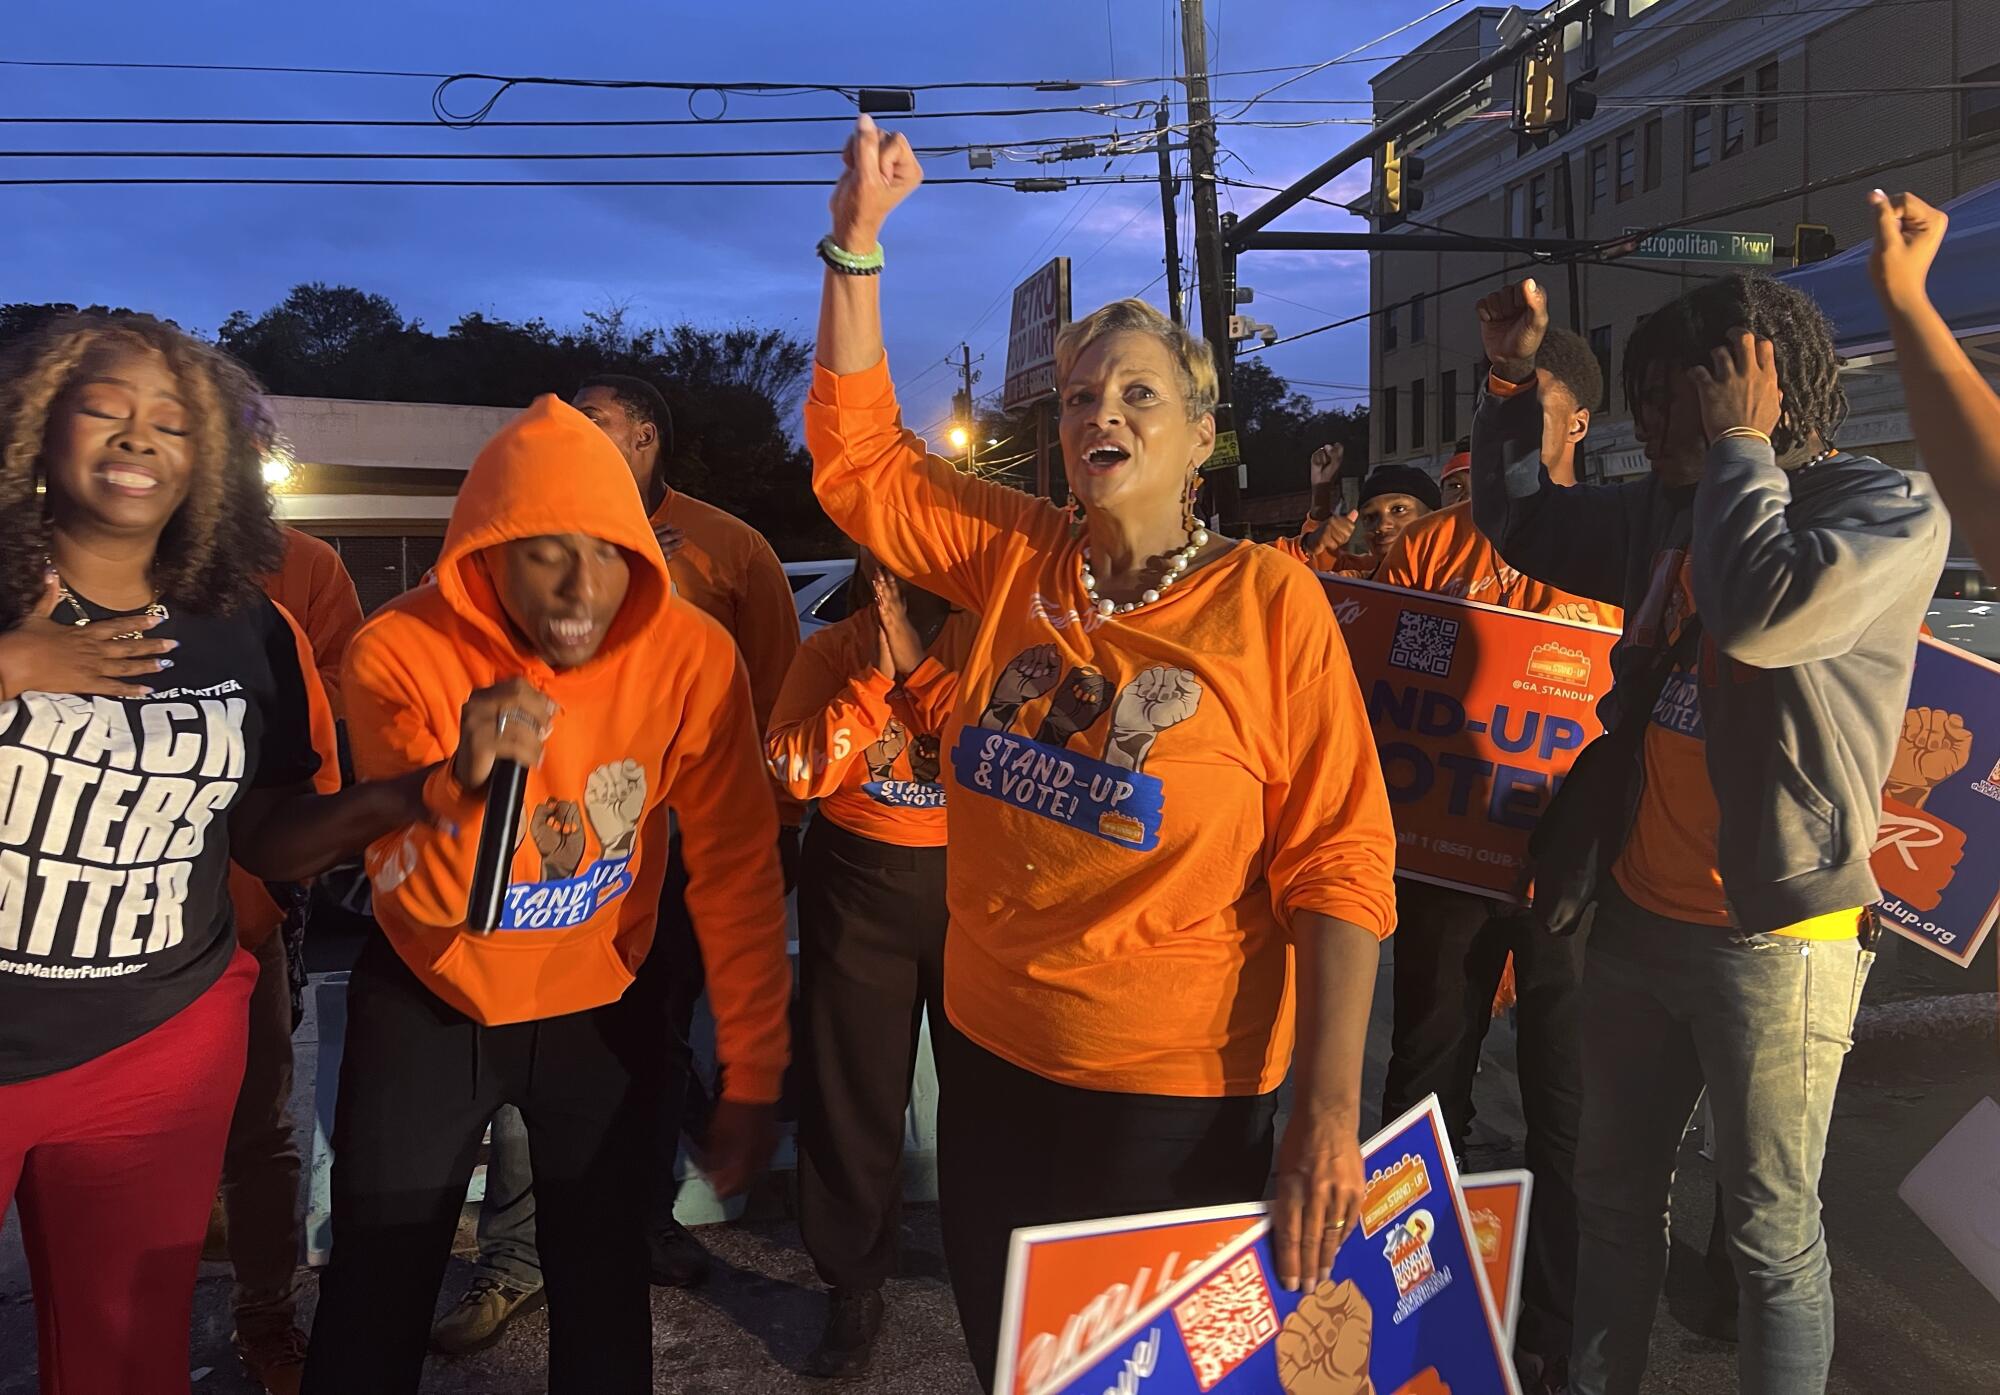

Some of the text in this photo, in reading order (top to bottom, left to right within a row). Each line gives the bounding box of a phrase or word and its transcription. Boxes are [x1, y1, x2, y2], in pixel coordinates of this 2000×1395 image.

[1626, 230, 1769, 259] etropolitan Pkwy
[152, 687, 180, 700] WE
[1512, 679, 1595, 703] @GA_STANDUP
[1371, 680, 1585, 761] ND-UP
[974, 762, 1080, 821] & VOTE!
[979, 733, 1134, 807] STAND-UP
[0, 745, 239, 865] OTERS
[1397, 831, 1416, 846] all
[0, 849, 193, 958] ATTER
[504, 861, 627, 910] TAND-UP
[514, 897, 591, 928] VOTE!
